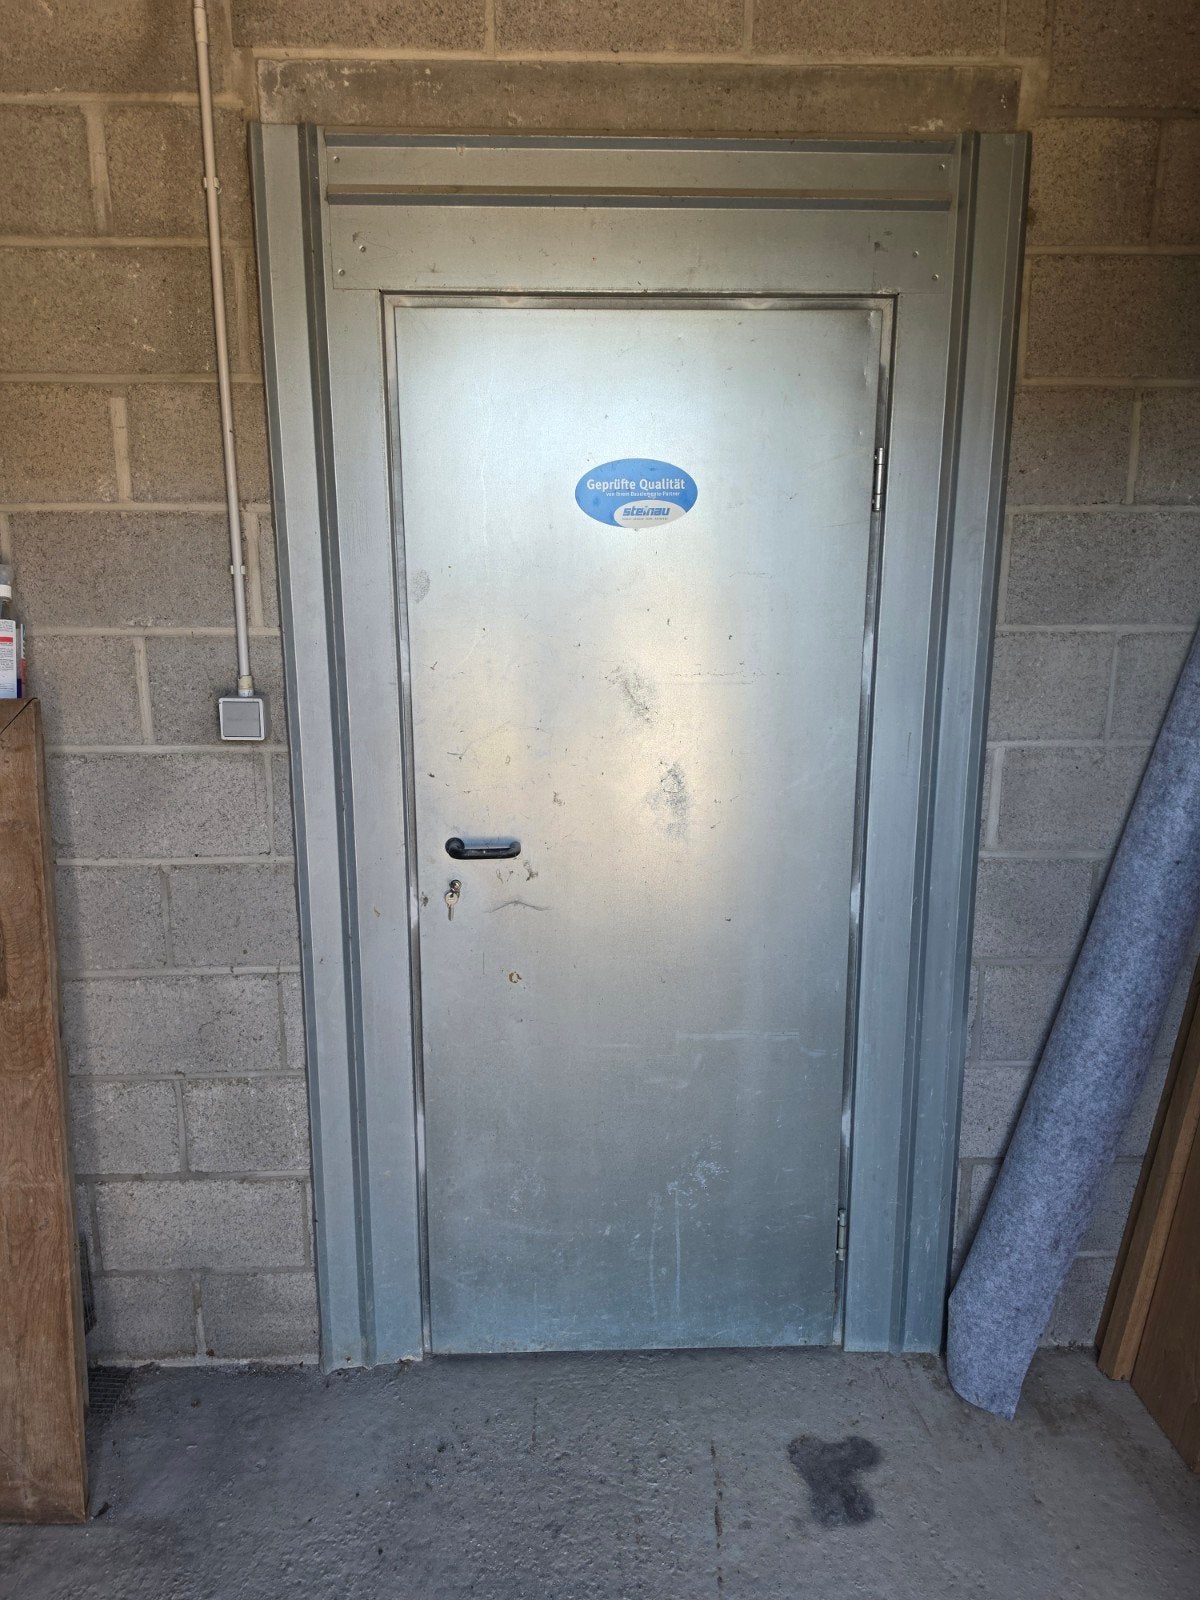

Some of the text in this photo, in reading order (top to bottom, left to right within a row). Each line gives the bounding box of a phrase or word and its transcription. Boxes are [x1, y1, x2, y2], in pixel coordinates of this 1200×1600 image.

[586, 478, 685, 492] Geprüfte Qualität
[622, 505, 671, 516] steinau
